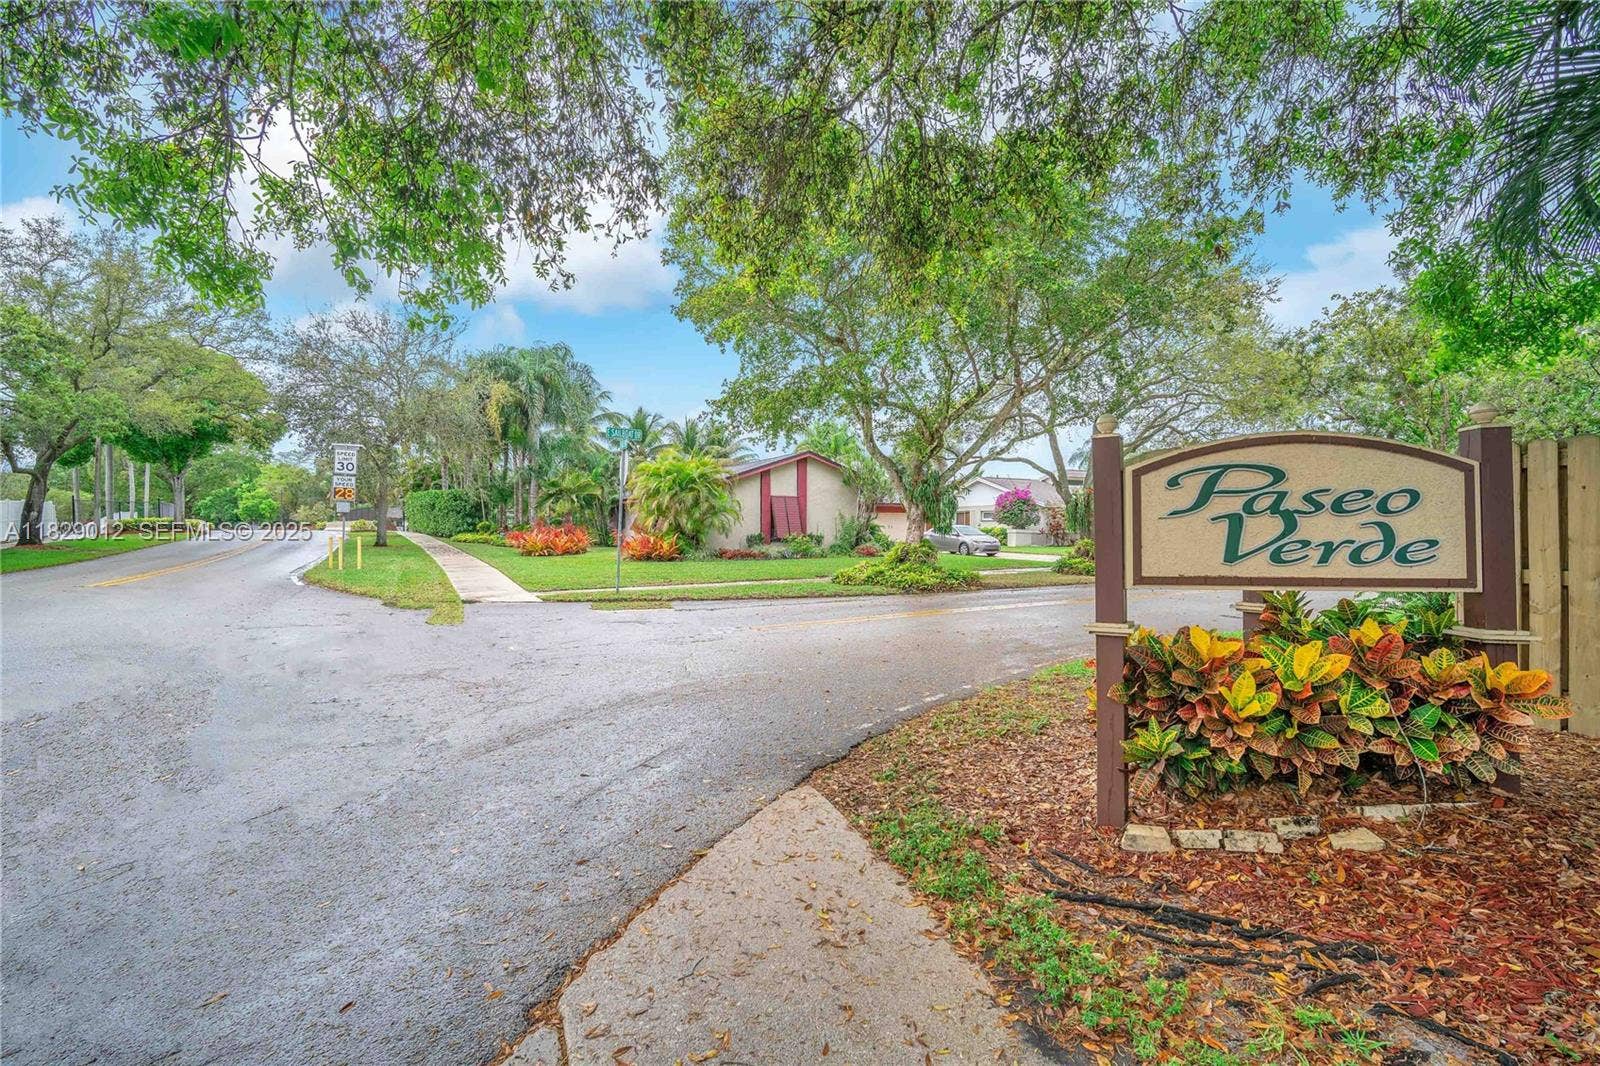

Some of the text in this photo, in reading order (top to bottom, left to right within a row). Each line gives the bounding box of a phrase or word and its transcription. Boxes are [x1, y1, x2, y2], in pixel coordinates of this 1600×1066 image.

[336, 461, 355, 472] 30
[1159, 462, 1422, 519] Paseo
[1209, 511, 1441, 567] Verde
